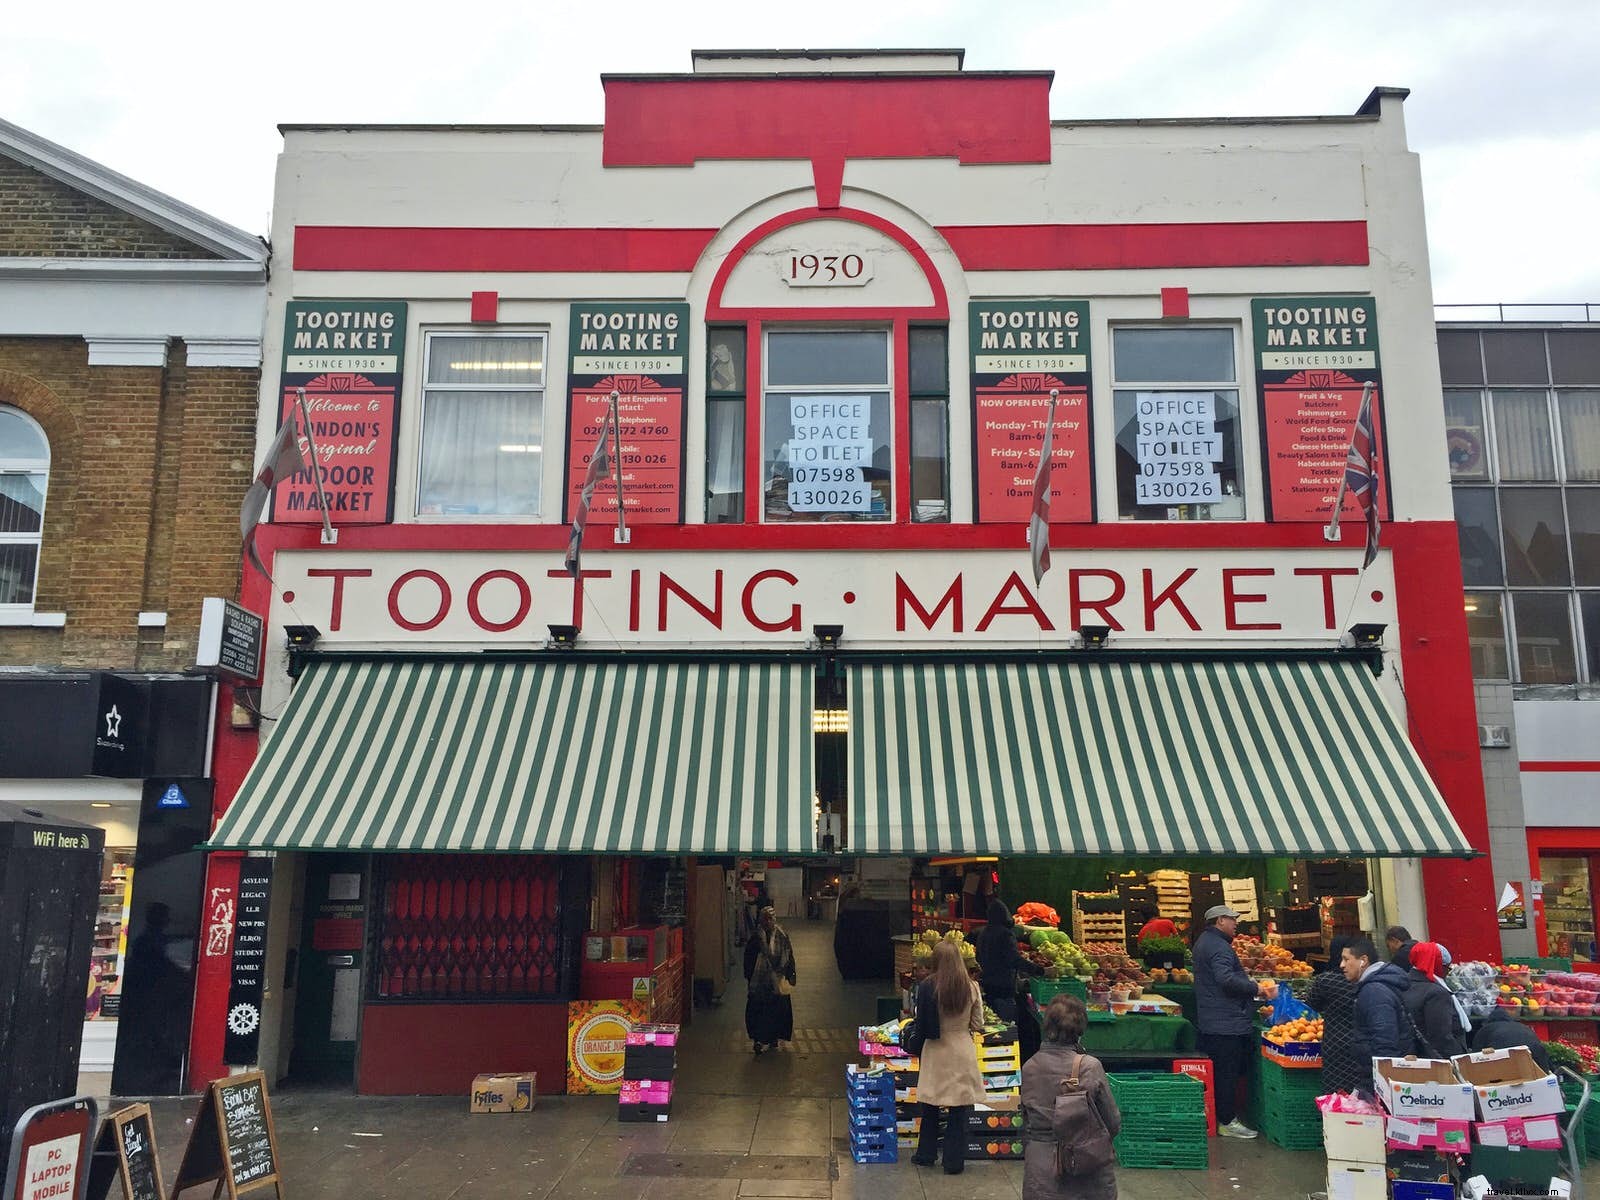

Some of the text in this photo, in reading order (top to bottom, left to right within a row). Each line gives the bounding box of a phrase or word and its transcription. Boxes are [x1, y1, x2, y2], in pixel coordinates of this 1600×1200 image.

[791, 254, 863, 281] 1930
[296, 312, 394, 329] TOOTING
[580, 313, 679, 330] TOOTING
[979, 311, 1079, 329] TOOTING
[1264, 307, 1366, 325] TOOTING
[294, 332, 393, 349] MARKET
[580, 333, 678, 350] MARKET
[981, 331, 1079, 349] MARKET
[1267, 328, 1367, 346] MARKET
[308, 360, 376, 369] SINCE 1930
[595, 361, 661, 370] SINCE 1930
[997, 359, 1064, 368] SINCE 1930
[1284, 355, 1353, 365] SINCE 1930
[981, 399, 1003, 407] NOW
[1005, 399, 1030, 407] OPEN
[1063, 398, 1083, 406] DAY
[1327, 393, 1342, 401] Veg
[367, 400, 381, 411] to
[794, 404, 861, 419] OFFICE
[1140, 400, 1206, 415] OFFICE
[641, 426, 669, 435] 4760
[798, 425, 860, 440] SPACE
[1143, 421, 1206, 436] SPACE
[1327, 426, 1346, 434] Shop
[1140, 441, 1214, 456] TO LET
[623, 455, 642, 464] 130
[645, 455, 667, 464] 026
[796, 467, 855, 482] 07598
[1144, 462, 1205, 477] 07598
[1140, 482, 1213, 497] 130026
[287, 491, 373, 511] MARKET
[791, 490, 862, 505] 130026
[307, 567, 1359, 632] TOOTING MARKET
[33, 830, 79, 849] WiFi here
[584, 1041, 612, 1052] ORANGE
[1290, 1053, 1320, 1062] nobel
[1400, 1095, 1444, 1106] Melinda
[1488, 1094, 1532, 1109] Melinda
[47, 1148, 62, 1162] PC
[31, 1163, 71, 1184] LAPTOP
[33, 1181, 70, 1200] MOBILE
